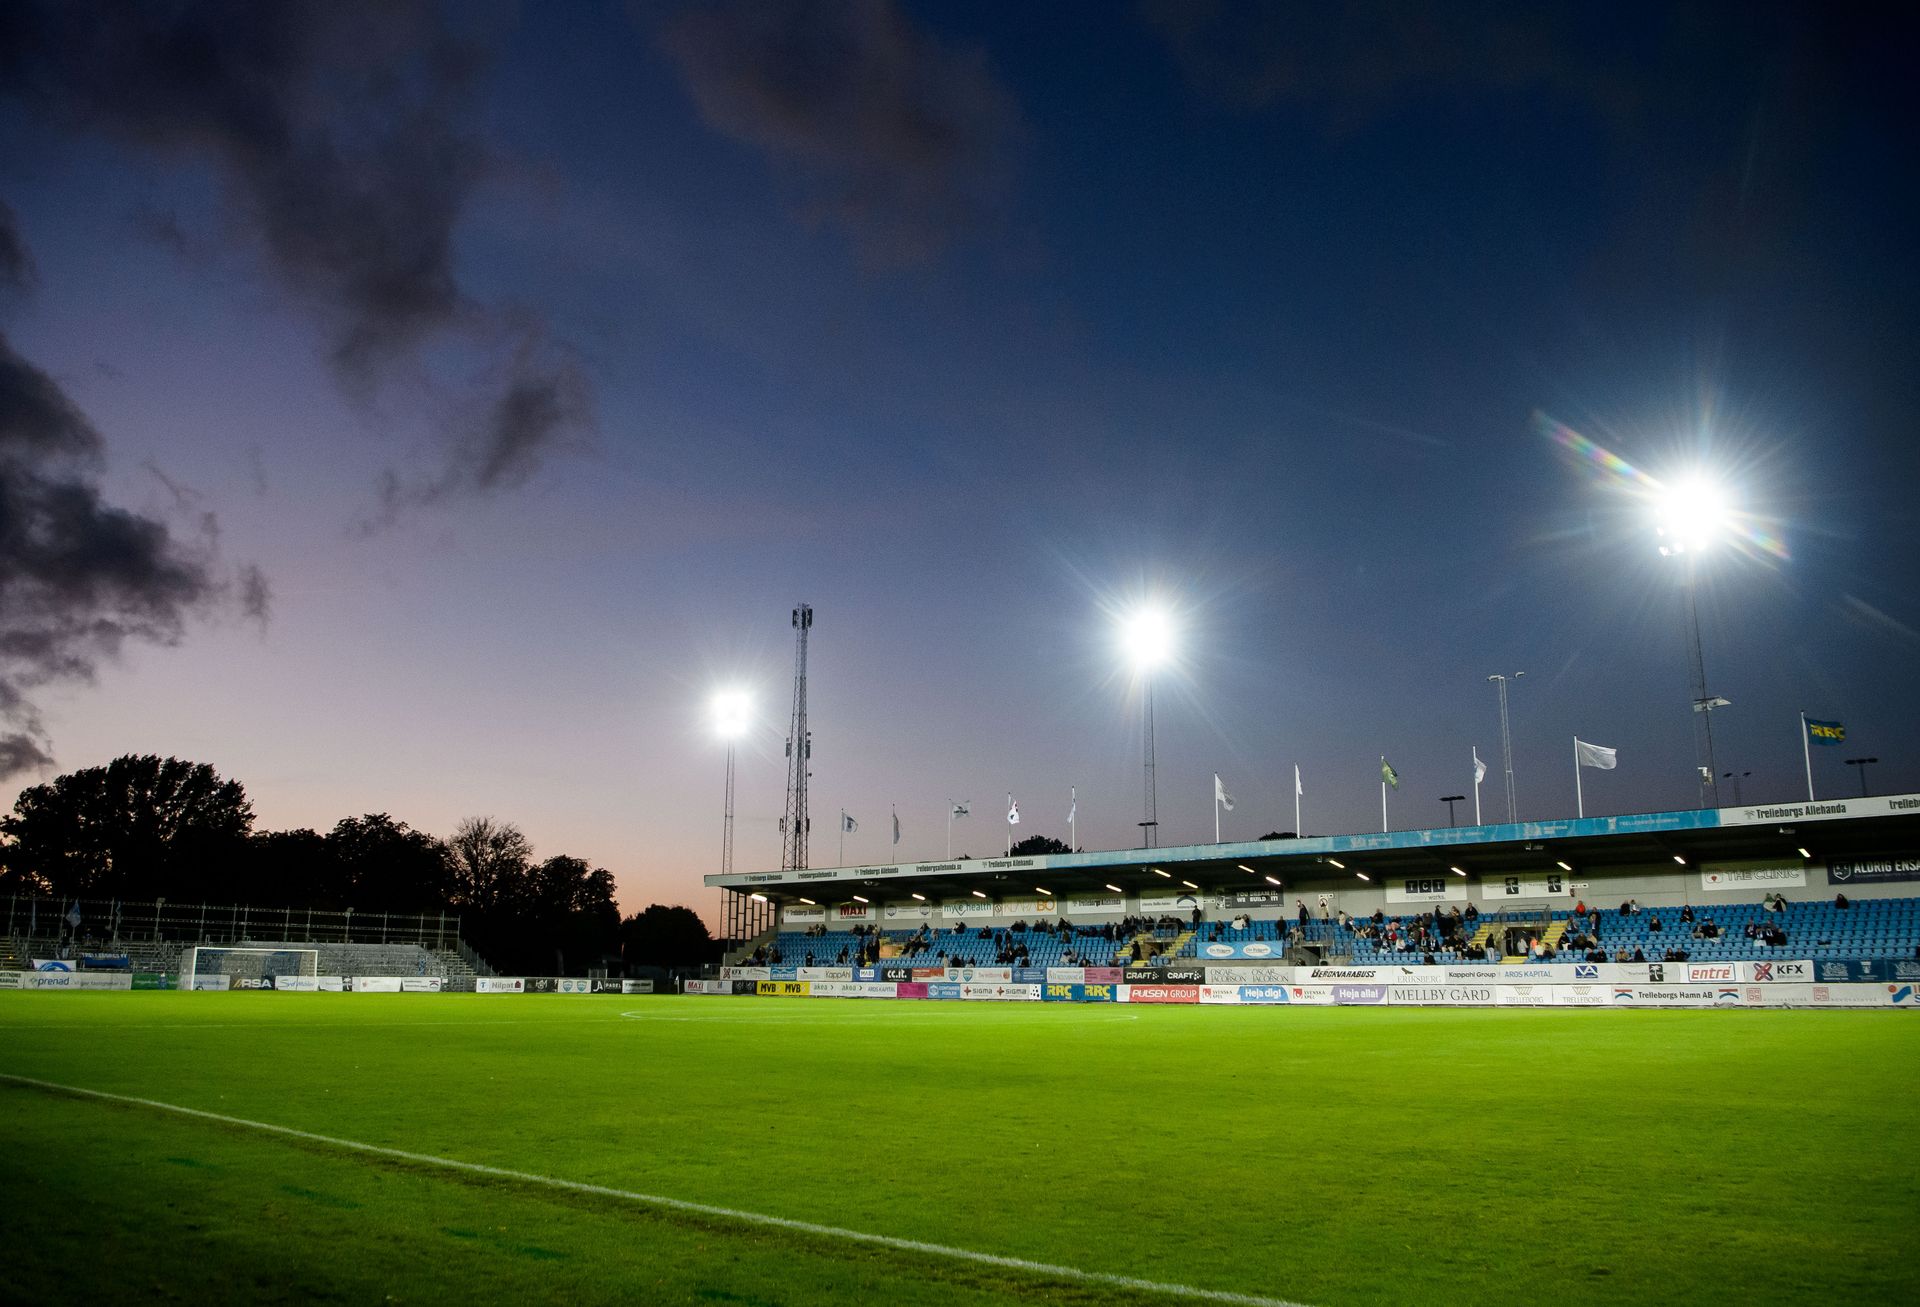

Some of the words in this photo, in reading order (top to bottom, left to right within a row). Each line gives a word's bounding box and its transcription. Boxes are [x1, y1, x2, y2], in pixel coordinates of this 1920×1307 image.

[1756, 805, 1804, 819] Trelleborgs
[1805, 803, 1847, 816] Allehanda
[1854, 860, 1892, 874] ALDRIG
[1727, 871, 1752, 881] THE
[1753, 868, 1800, 880] CLINIC
[1504, 970, 1522, 978] AROS
[1523, 970, 1552, 978] KAPITAL
[1777, 965, 1803, 974] KFX
[1476, 971, 1496, 979] Group
[37, 977, 70, 987] prenad
[761, 984, 776, 992] MVB
[785, 984, 801, 993] MVB
[1132, 990, 1168, 998] PULSEN
[1170, 990, 1197, 998] GROUP
[1245, 988, 1264, 998] Heja
[1339, 989, 1360, 999] Heja
[1394, 989, 1447, 1001] MELLBY
[1450, 987, 1490, 1001] GÅRD
[1638, 991, 1678, 1000] Trelleborgs
[1679, 991, 1701, 999] Hamn
[1702, 991, 1713, 999] AB
[1563, 996, 1603, 1004] TRELLEBORG
